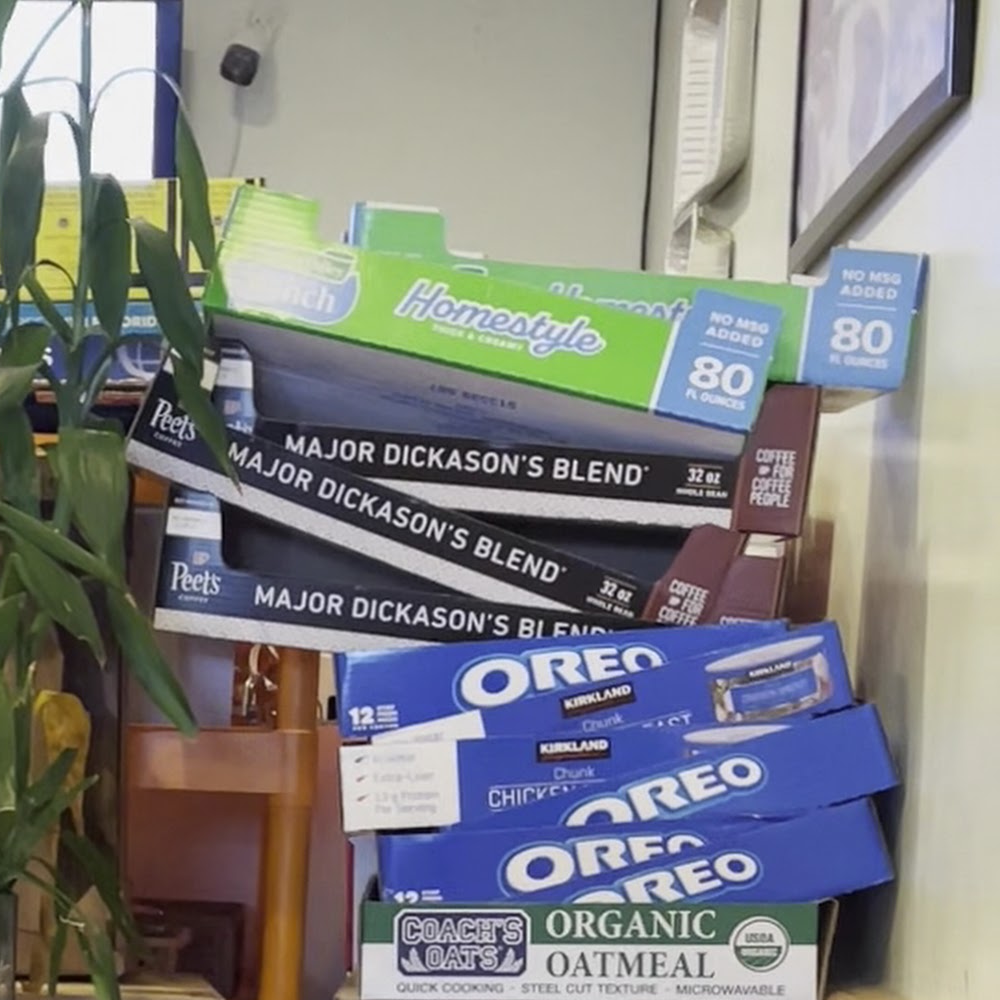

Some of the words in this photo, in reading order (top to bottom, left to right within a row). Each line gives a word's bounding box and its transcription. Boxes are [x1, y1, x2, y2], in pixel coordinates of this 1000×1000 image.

[842, 269, 865, 283] NO
[869, 271, 901, 285] MSG
[840, 284, 897, 300] ADDED
[394, 278, 605, 357] Homestyle
[709, 311, 732, 326] NO
[736, 317, 770, 335] MSG
[706, 327, 764, 348] ADDED
[830, 317, 893, 354] 80
[844, 355, 888, 369] OUNCES
[688, 356, 753, 397] 80
[686, 389, 699, 401] FL
[700, 391, 746, 411] OUNCES
[285, 434, 374, 463] MAJOR
[383, 446, 543, 477] DICKASON'S
[553, 458, 642, 486] BLEND
[756, 449, 797, 465] COFFEE
[687, 468, 703, 483] 32
[752, 477, 792, 494] COFFEE
[750, 492, 790, 509] PEOPLE
[228, 442, 314, 492] MAJOR
[317, 477, 470, 550] DICKASON'S
[473, 536, 559, 583] BLEND
[599, 579, 617, 597] 32
[669, 579, 709, 600] COFFEE
[255, 585, 343, 616] MAJOR
[352, 598, 509, 636] DICKASON'S
[460, 647, 663, 707] OREO
[564, 685, 632, 709] KIRKLAND
[349, 707, 374, 725] 12
[582, 714, 624, 732] Chunk
[539, 740, 609, 754] KIRKLAND
[554, 767, 595, 780] Chunk
[401, 916, 524, 944] COACH'S
[545, 909, 716, 939] ORGANIC
[745, 932, 775, 943] USDA
[425, 945, 499, 970] OATS
[545, 951, 715, 978] OATMEAL
[397, 982, 438, 994] QUICK
[442, 982, 504, 994] COOKING
[521, 983, 560, 994] STEEL
[566, 983, 593, 994] CUT
[598, 983, 657, 995] TEXTURE
[676, 984, 786, 996] MICROWAVABLE
